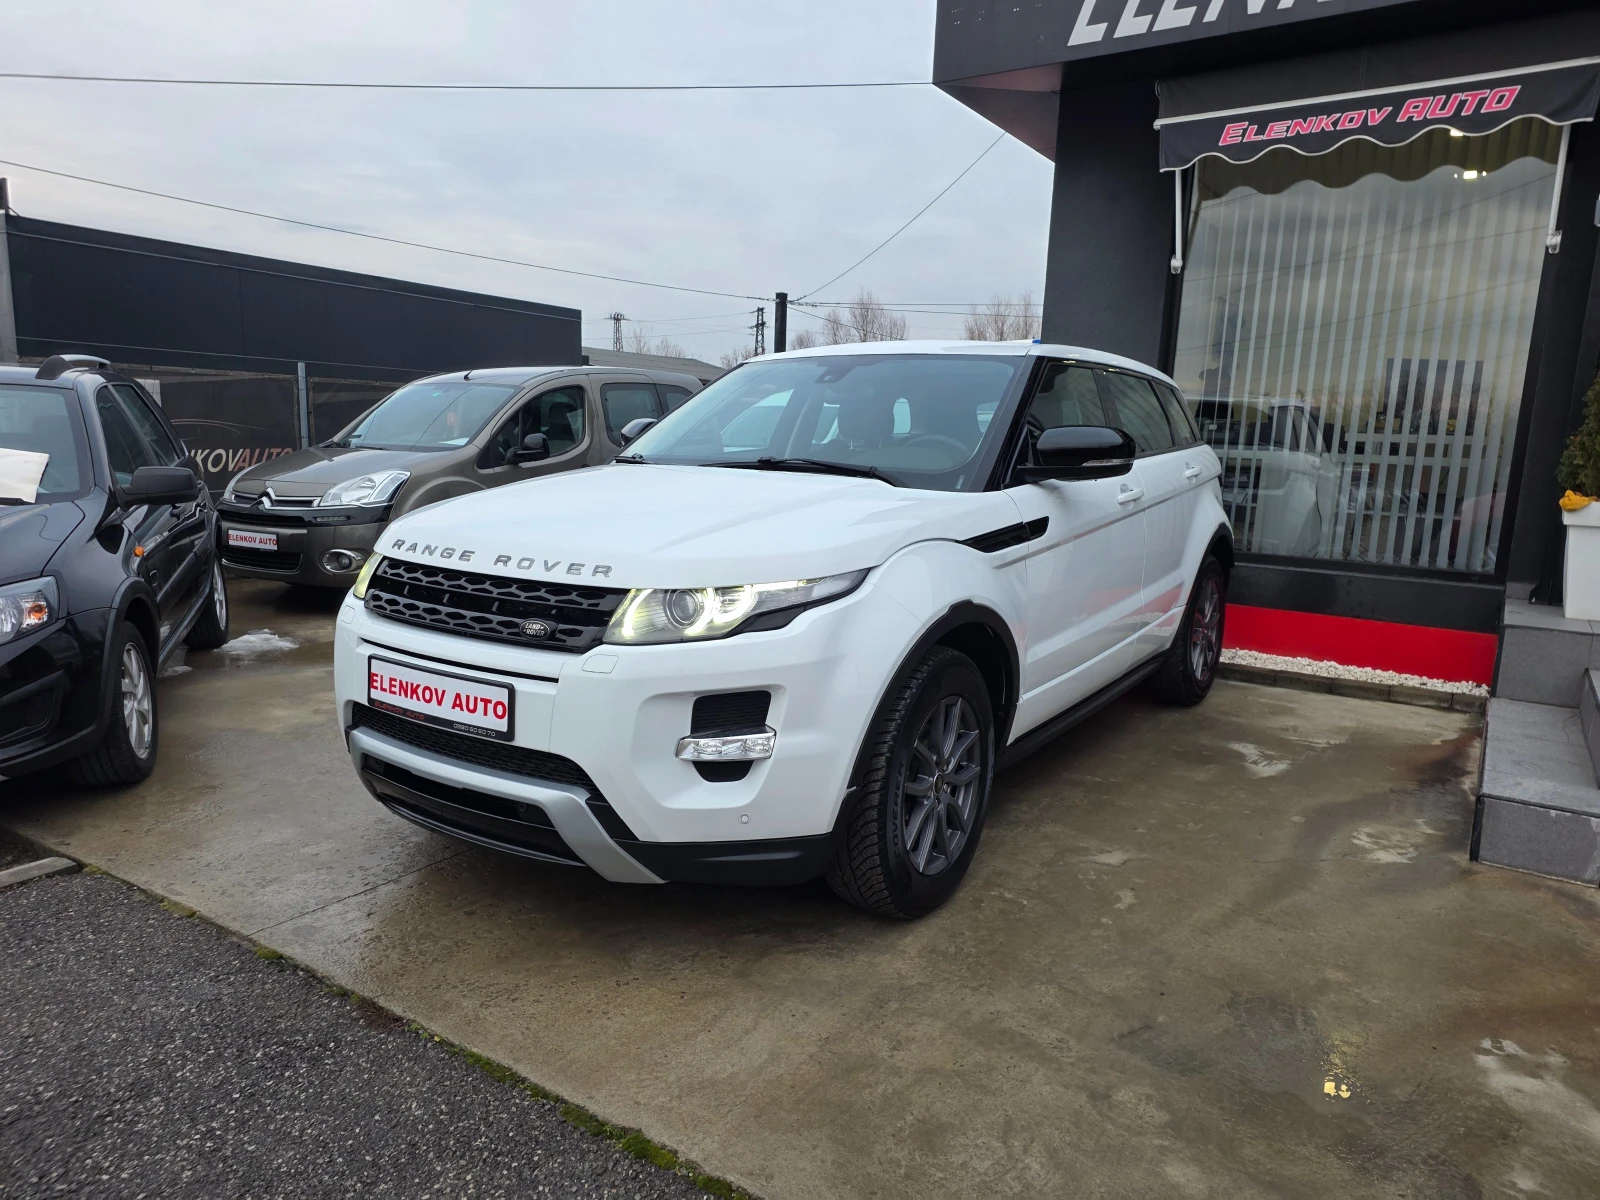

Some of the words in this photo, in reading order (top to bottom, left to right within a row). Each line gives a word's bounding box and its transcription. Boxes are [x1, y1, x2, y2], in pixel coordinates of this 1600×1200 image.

[1219, 107, 1392, 146] ELENKOV
[1396, 85, 1522, 123] AUTO
[228, 534, 257, 543] ELENKOV
[259, 537, 279, 546] AUTO
[391, 538, 475, 562] RANGE
[494, 554, 612, 578] ROVER
[370, 671, 446, 706] ELENKOV
[451, 692, 507, 720] AUTO
[406, 710, 425, 720] AUTO
